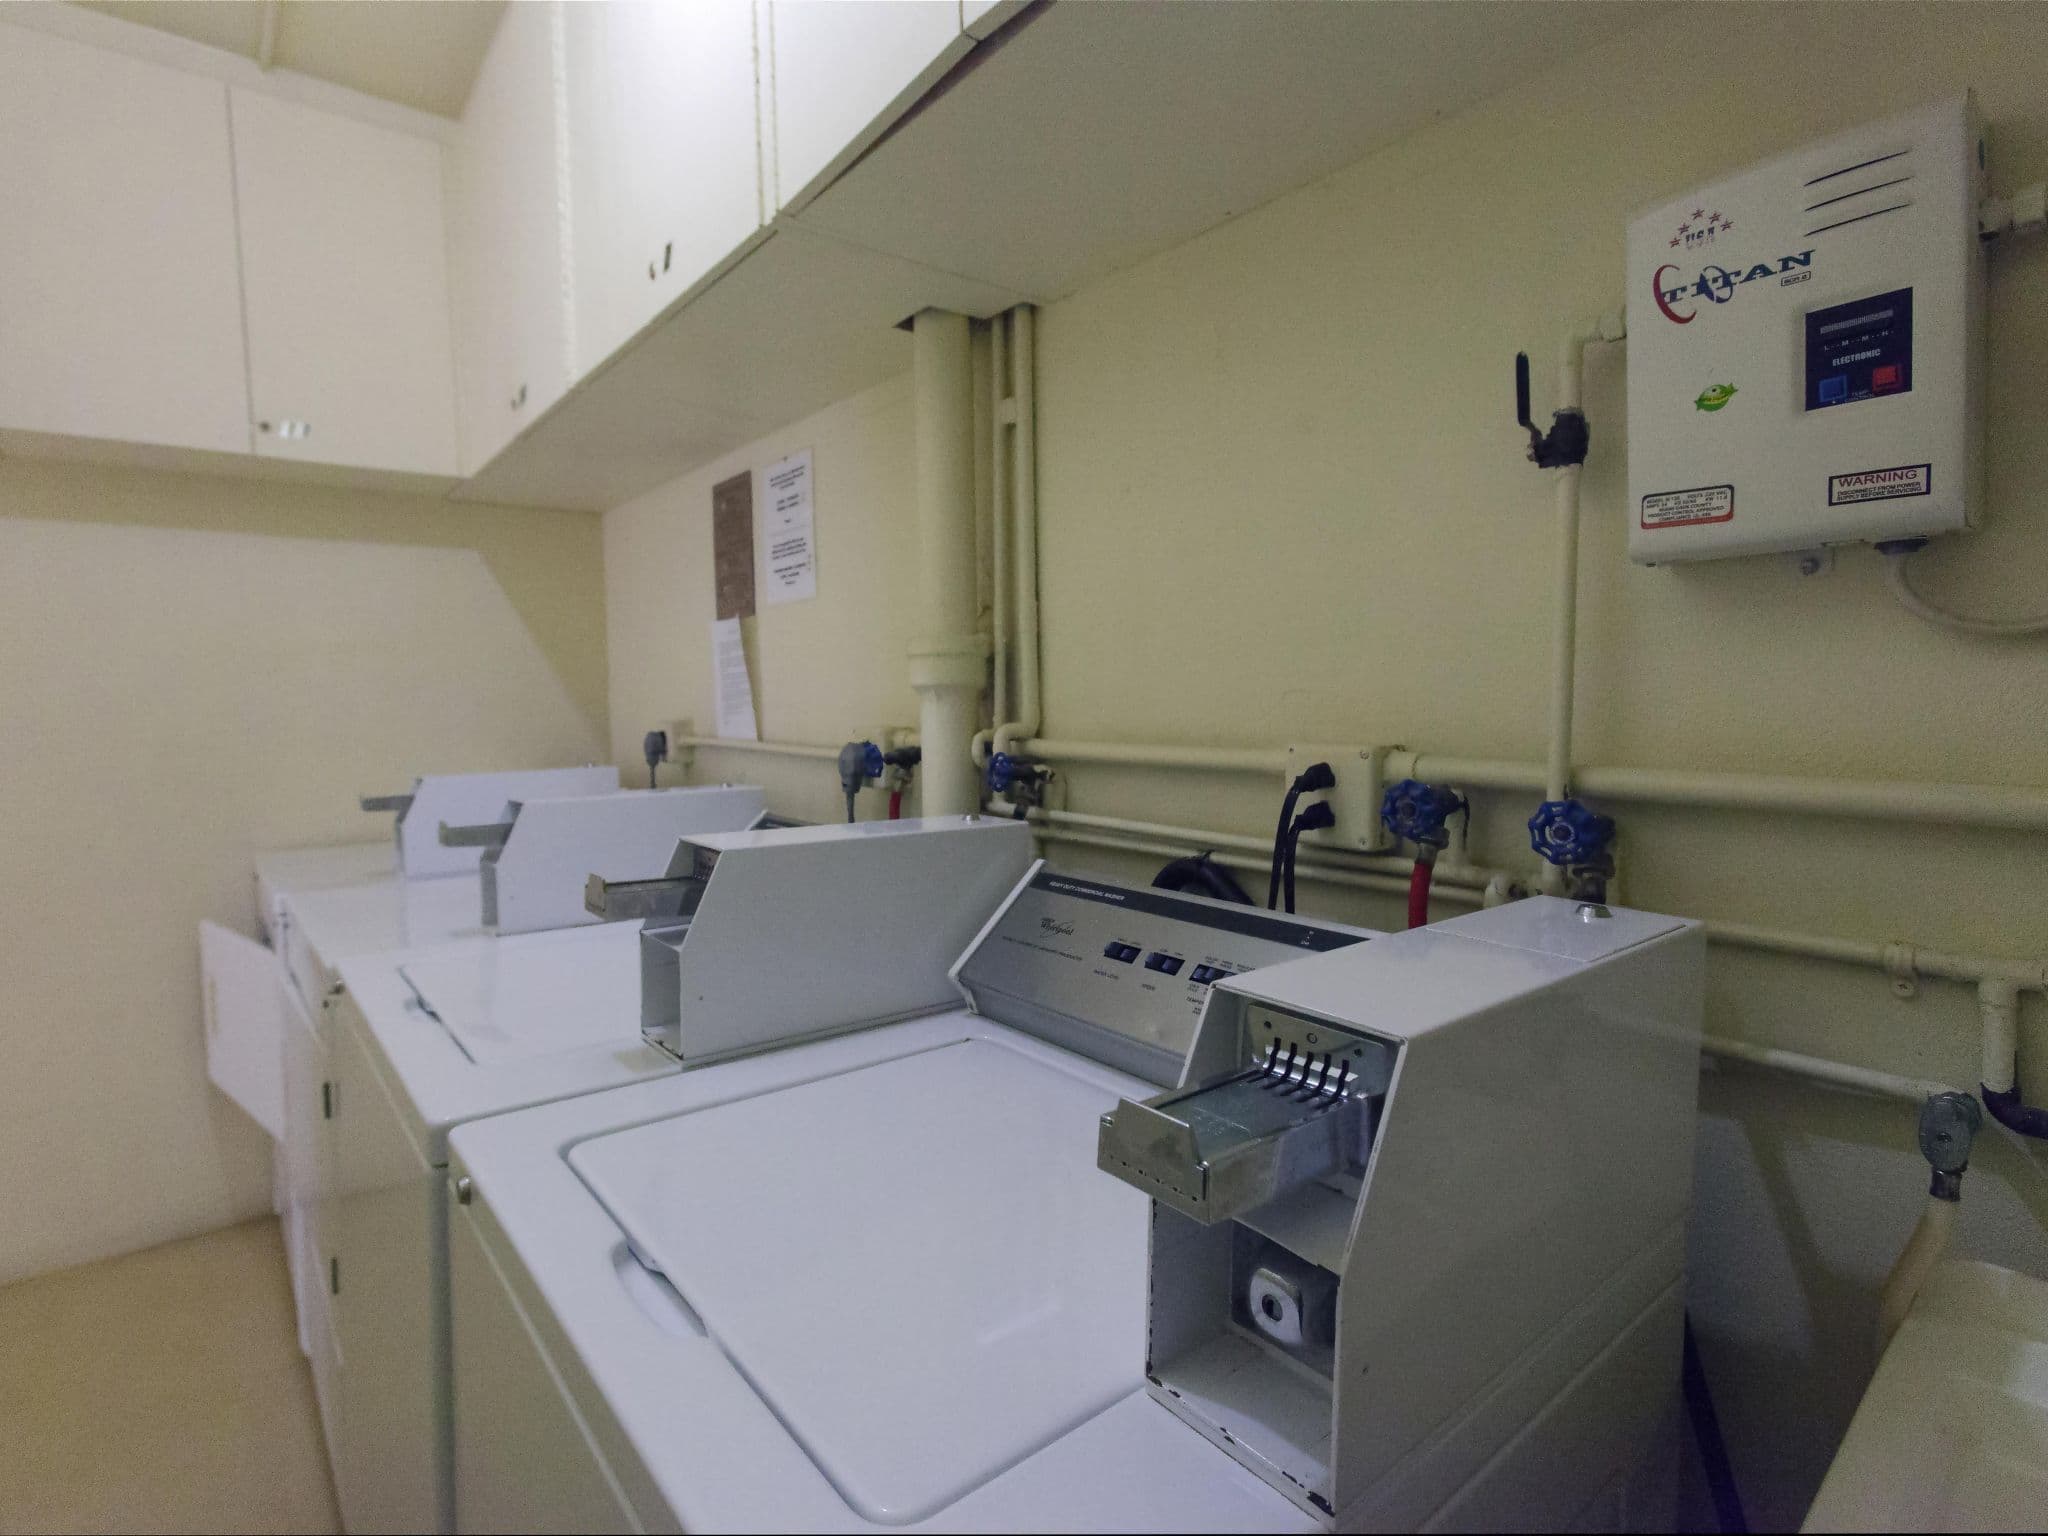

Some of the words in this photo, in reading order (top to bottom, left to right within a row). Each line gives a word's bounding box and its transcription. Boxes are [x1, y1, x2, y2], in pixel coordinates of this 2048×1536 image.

[1661, 249, 1816, 304] TITAN
[1832, 348, 1881, 367] ELECTRONIC
[1838, 469, 1917, 487] WARNING
[1837, 486, 1877, 497] DISCONNECT
[1896, 481, 1921, 489] POWER
[1860, 490, 1886, 498] BEFORE
[1886, 486, 1922, 495] SERVICING
